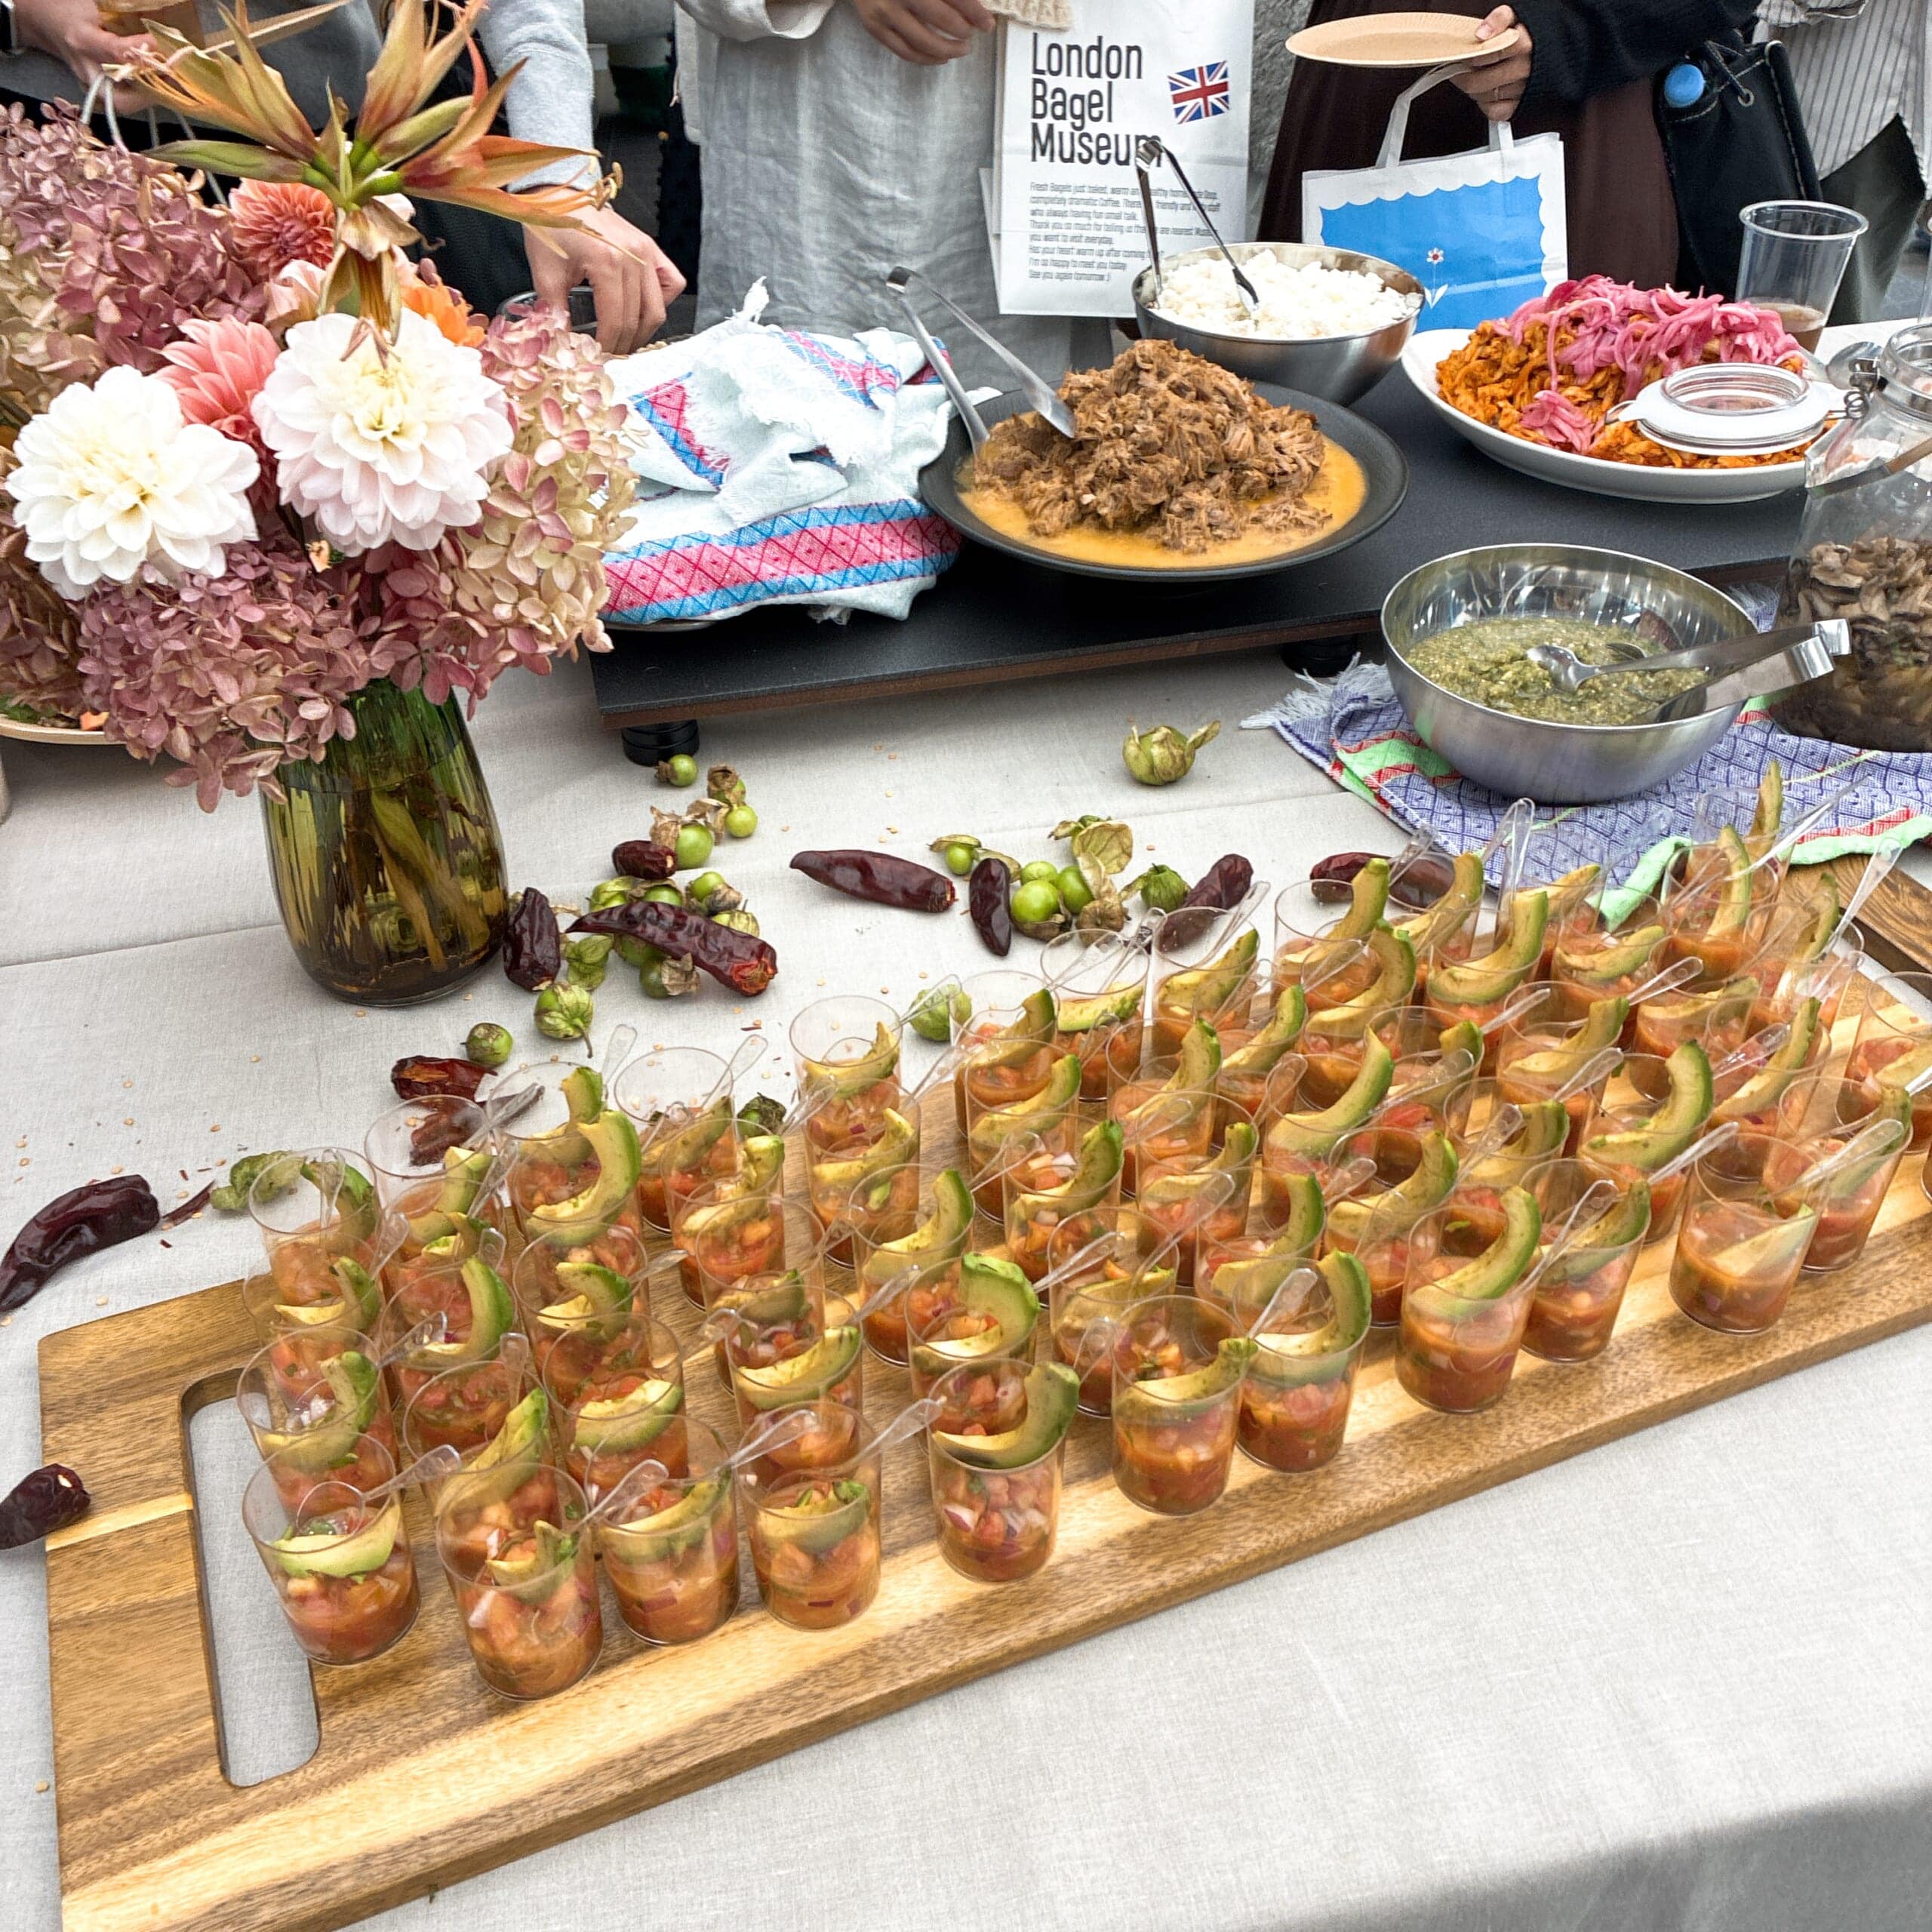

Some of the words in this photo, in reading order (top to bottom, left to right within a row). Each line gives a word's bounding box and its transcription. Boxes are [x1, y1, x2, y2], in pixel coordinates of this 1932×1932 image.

[1032, 32, 1142, 78] London
[1032, 77, 1112, 131] Bagel
[1030, 182, 1048, 191] Fresh
[1051, 183, 1072, 193] Bagels
[1073, 186, 1086, 194] just
[1030, 196, 1066, 206] completely
[1068, 198, 1097, 206] dramatic
[1046, 209, 1069, 218] always
[1069, 210, 1091, 220] having
[1105, 211, 1121, 220] small
[1030, 220, 1049, 229] Thank
[1029, 234, 1041, 242] you
[1106, 248, 1121, 257] after
[1123, 250, 1145, 260] coming
[1051, 260, 1069, 268] happy
[1029, 269, 1041, 278] See
[1042, 272, 1053, 280] you
[1055, 272, 1072, 281] again
